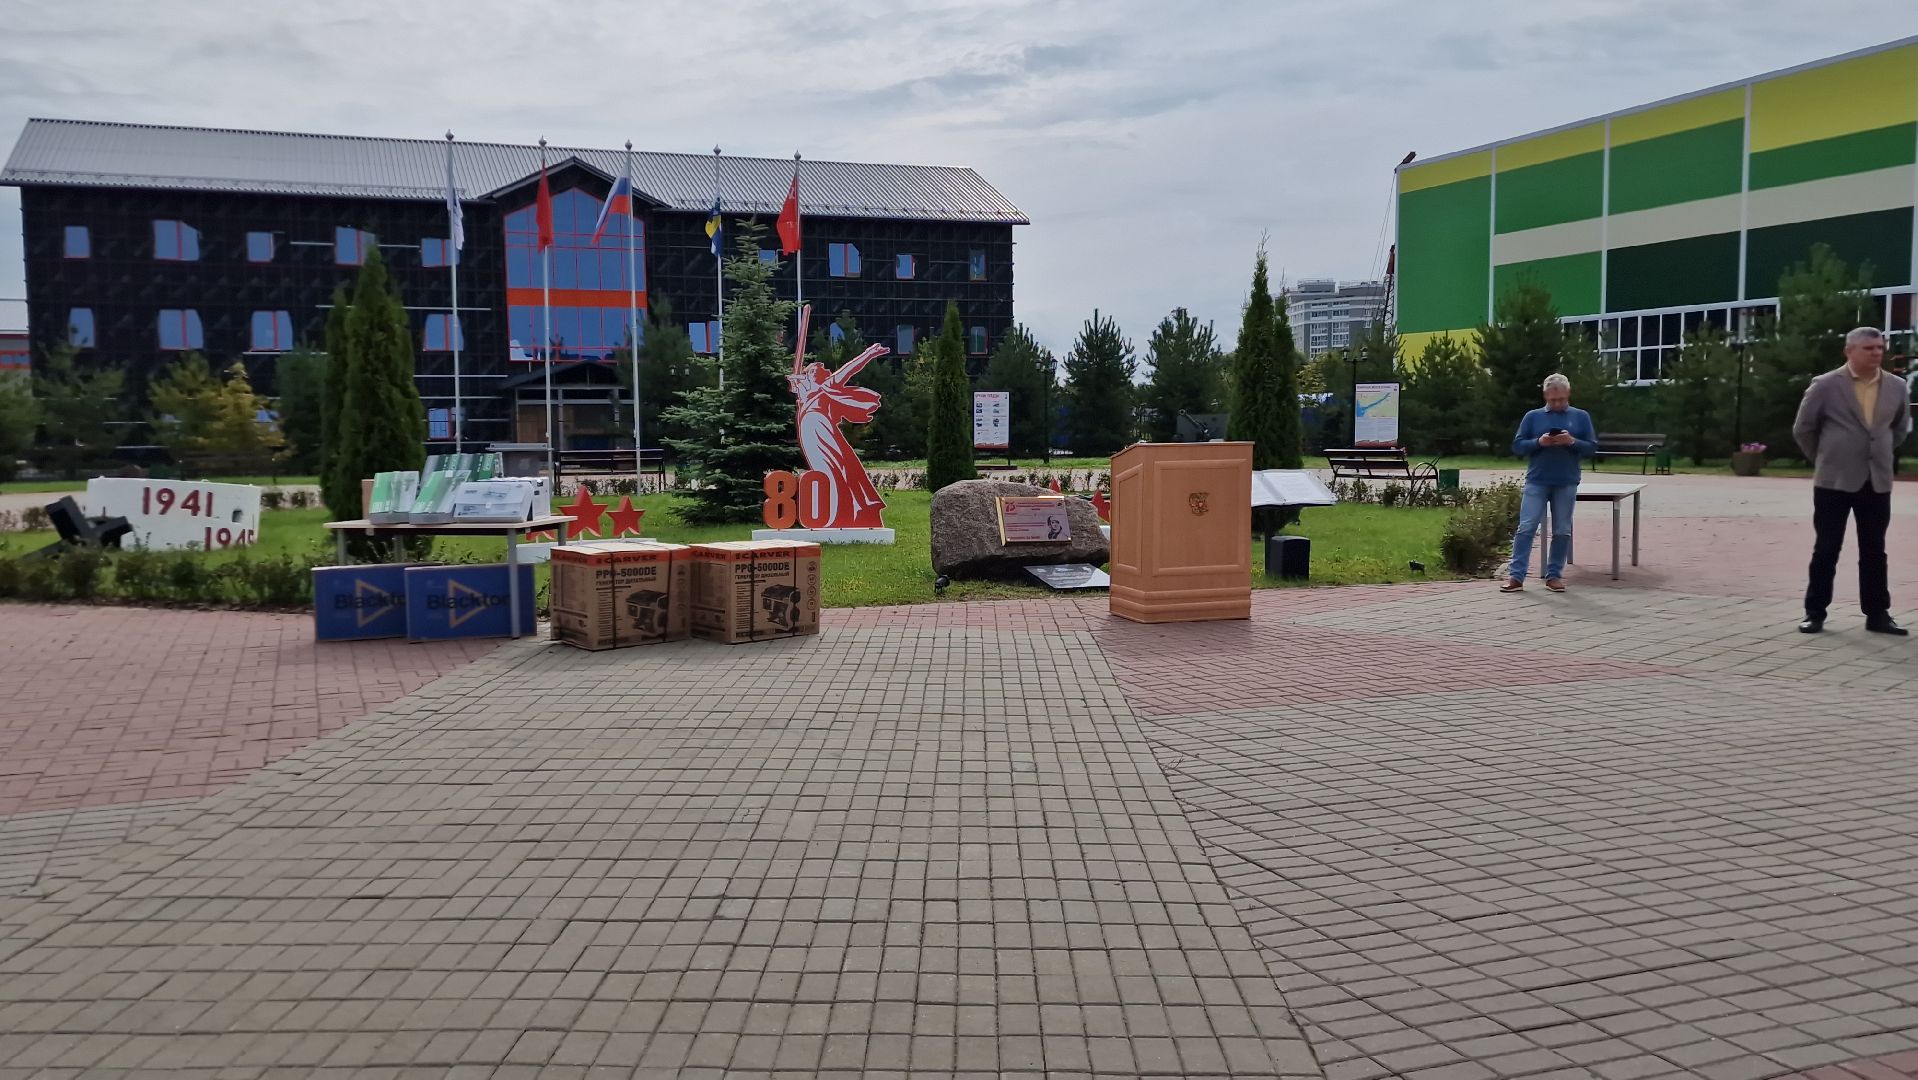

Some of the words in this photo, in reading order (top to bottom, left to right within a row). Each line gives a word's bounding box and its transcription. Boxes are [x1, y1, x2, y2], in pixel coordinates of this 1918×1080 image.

[142, 486, 214, 517] 1941
[763, 470, 830, 529] 80
[604, 555, 657, 564] CARVER
[741, 551, 790, 559] CARVER
